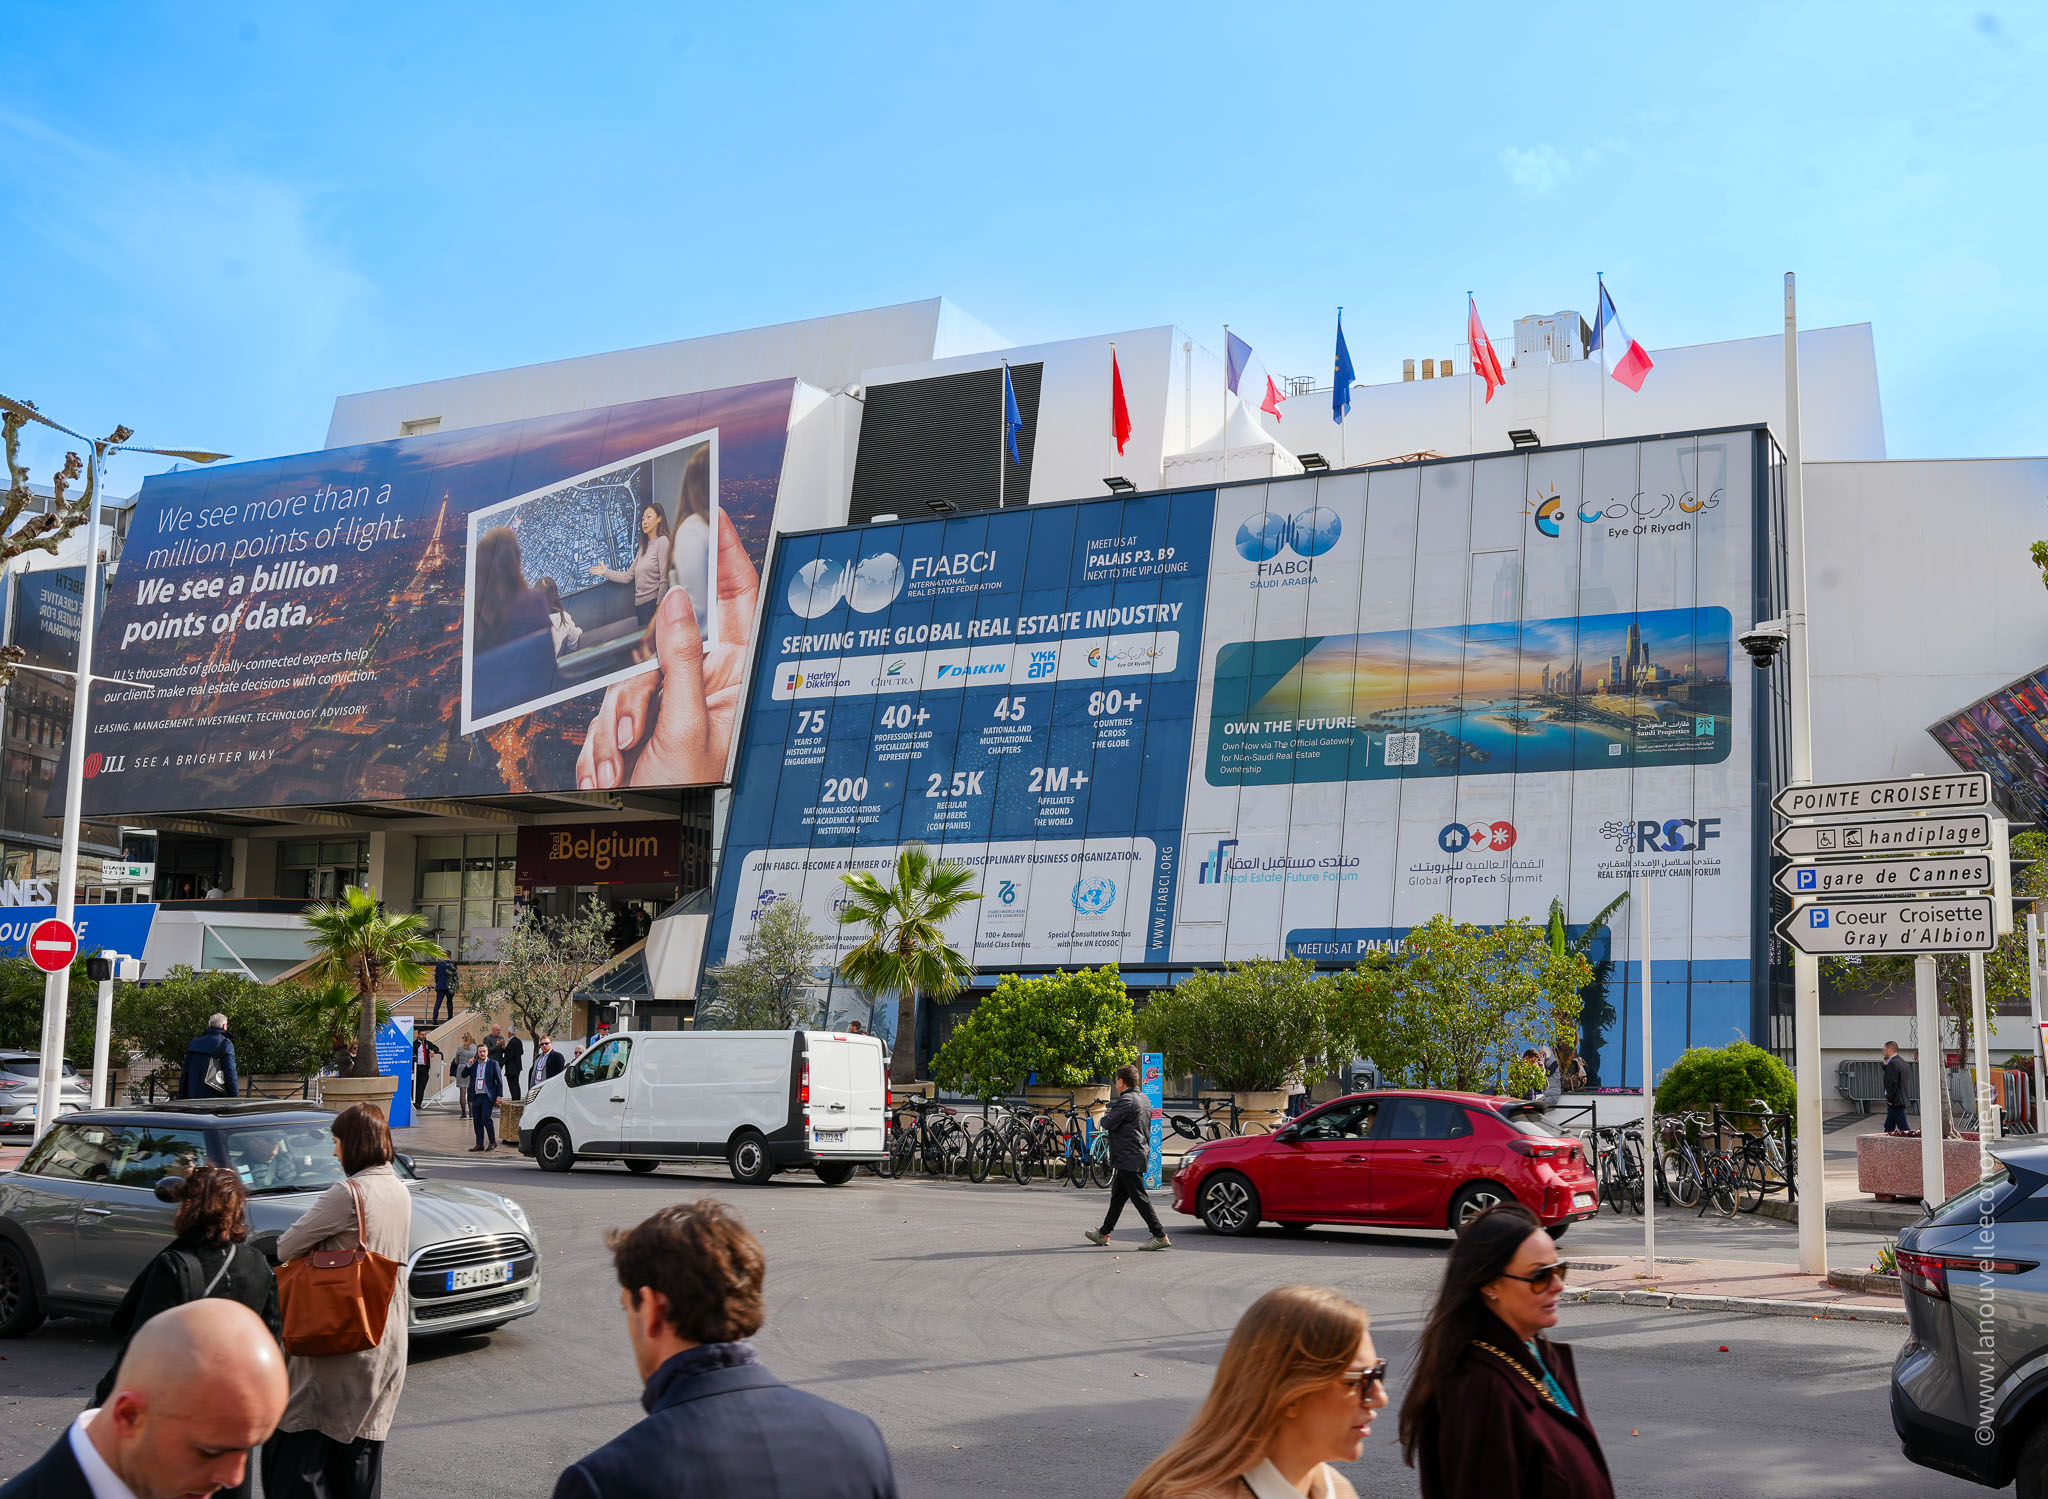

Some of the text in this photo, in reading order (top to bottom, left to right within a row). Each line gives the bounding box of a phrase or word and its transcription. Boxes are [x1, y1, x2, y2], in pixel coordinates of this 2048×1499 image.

[158, 483, 392, 533] We see more than a
[1608, 521, 1691, 539] Eye Of Riyadh
[145, 513, 407, 570] million points of light.
[1091, 536, 1138, 550] MEET US AT
[910, 550, 997, 579] FIABCI
[1089, 547, 1175, 568] PALAIS P3. B9
[1087, 562, 1188, 581] NEXT TO THE VIP LOUNGE
[1258, 560, 1313, 576] FIABCI
[136, 560, 338, 606] We see a billion
[907, 581, 1002, 598] REAL ESTATE FEDERATION
[909, 578, 967, 589] INTERNATIONAL
[1249, 576, 1319, 589] SAUDI ARABIA
[121, 601, 313, 649] points of data.
[781, 602, 1183, 654] SERVING THE GLOBAL REAL ESTATE INDUSTRY
[136, 663, 188, 681] thousands
[189, 660, 203, 677] of
[201, 655, 301, 680] globally-connected
[303, 651, 342, 670] experts
[343, 647, 369, 666] help
[1031, 650, 1056, 662] YKK
[807, 671, 837, 682] Harley
[951, 663, 1006, 678] DAIKIN
[104, 668, 378, 703] our clients make real estate decisions with conviction.
[806, 679, 850, 689] Dikkinson
[993, 696, 1026, 721] 45
[1087, 689, 1142, 717] 80+
[94, 704, 369, 734] LEASING. MANAGEMENT. INVESTMENT. TECHNOLOGY. ADVISORY.
[797, 710, 826, 734] 75
[880, 704, 931, 729] 40+
[1093, 718, 1133, 729] COUNTRIES
[983, 725, 1032, 735] NATIONAL AND
[1098, 729, 1126, 738] ACROSS
[1224, 716, 1357, 736] OWN THE FUTURE
[1636, 728, 1690, 738] Saudi Properties
[794, 736, 822, 746] YEARS OF
[874, 730, 932, 742] PROFESSIONS AND
[979, 735, 1033, 745] MULTINATIONAL
[786, 746, 826, 757] HISTORY AND
[874, 741, 929, 752] SPECIALIZATIONS
[987, 745, 1022, 755] CHAPTERS
[1091, 739, 1130, 750] THE GLOBE
[100, 749, 276, 774] JLL SEE A BRIGHTER WAY
[784, 756, 825, 766] ENGAGEMENT
[878, 751, 922, 761] REPRESENTED
[925, 771, 985, 798] 2.5K
[1027, 767, 1089, 793] 2M+
[822, 777, 868, 803] 200
[1793, 782, 1979, 810] POINTE CROISETTE
[1637, 818, 1721, 853] RSCF
[1870, 825, 1981, 845] handiplage
[550, 832, 560, 860] Real
[559, 829, 658, 869] Belgium
[752, 859, 892, 872] JOIN FIABCI. BECOME A MEMBER OF
[1027, 852, 1069, 865] BUSINESS
[1070, 851, 1142, 864] ORGANIZATION.
[1262, 856, 1315, 871] مستقبل
[1318, 855, 1360, 869] منتدى
[1466, 860, 1508, 872] العالمية
[1512, 859, 1544, 870] القمة
[1223, 871, 1358, 884] Real Estate Future Forum
[1408, 873, 1543, 886] Global PropTech Summit
[1801, 866, 1982, 890] P gare de Cannes
[1152, 846, 1173, 950] WWW.FIABCI.ORG
[1813, 906, 1982, 927] P Coeur Croisette
[1048, 929, 1131, 940] Special Consultative Status
[1844, 927, 1985, 948] Gray d'Albion
[1057, 938, 1119, 948] with the UN ECOSOC
